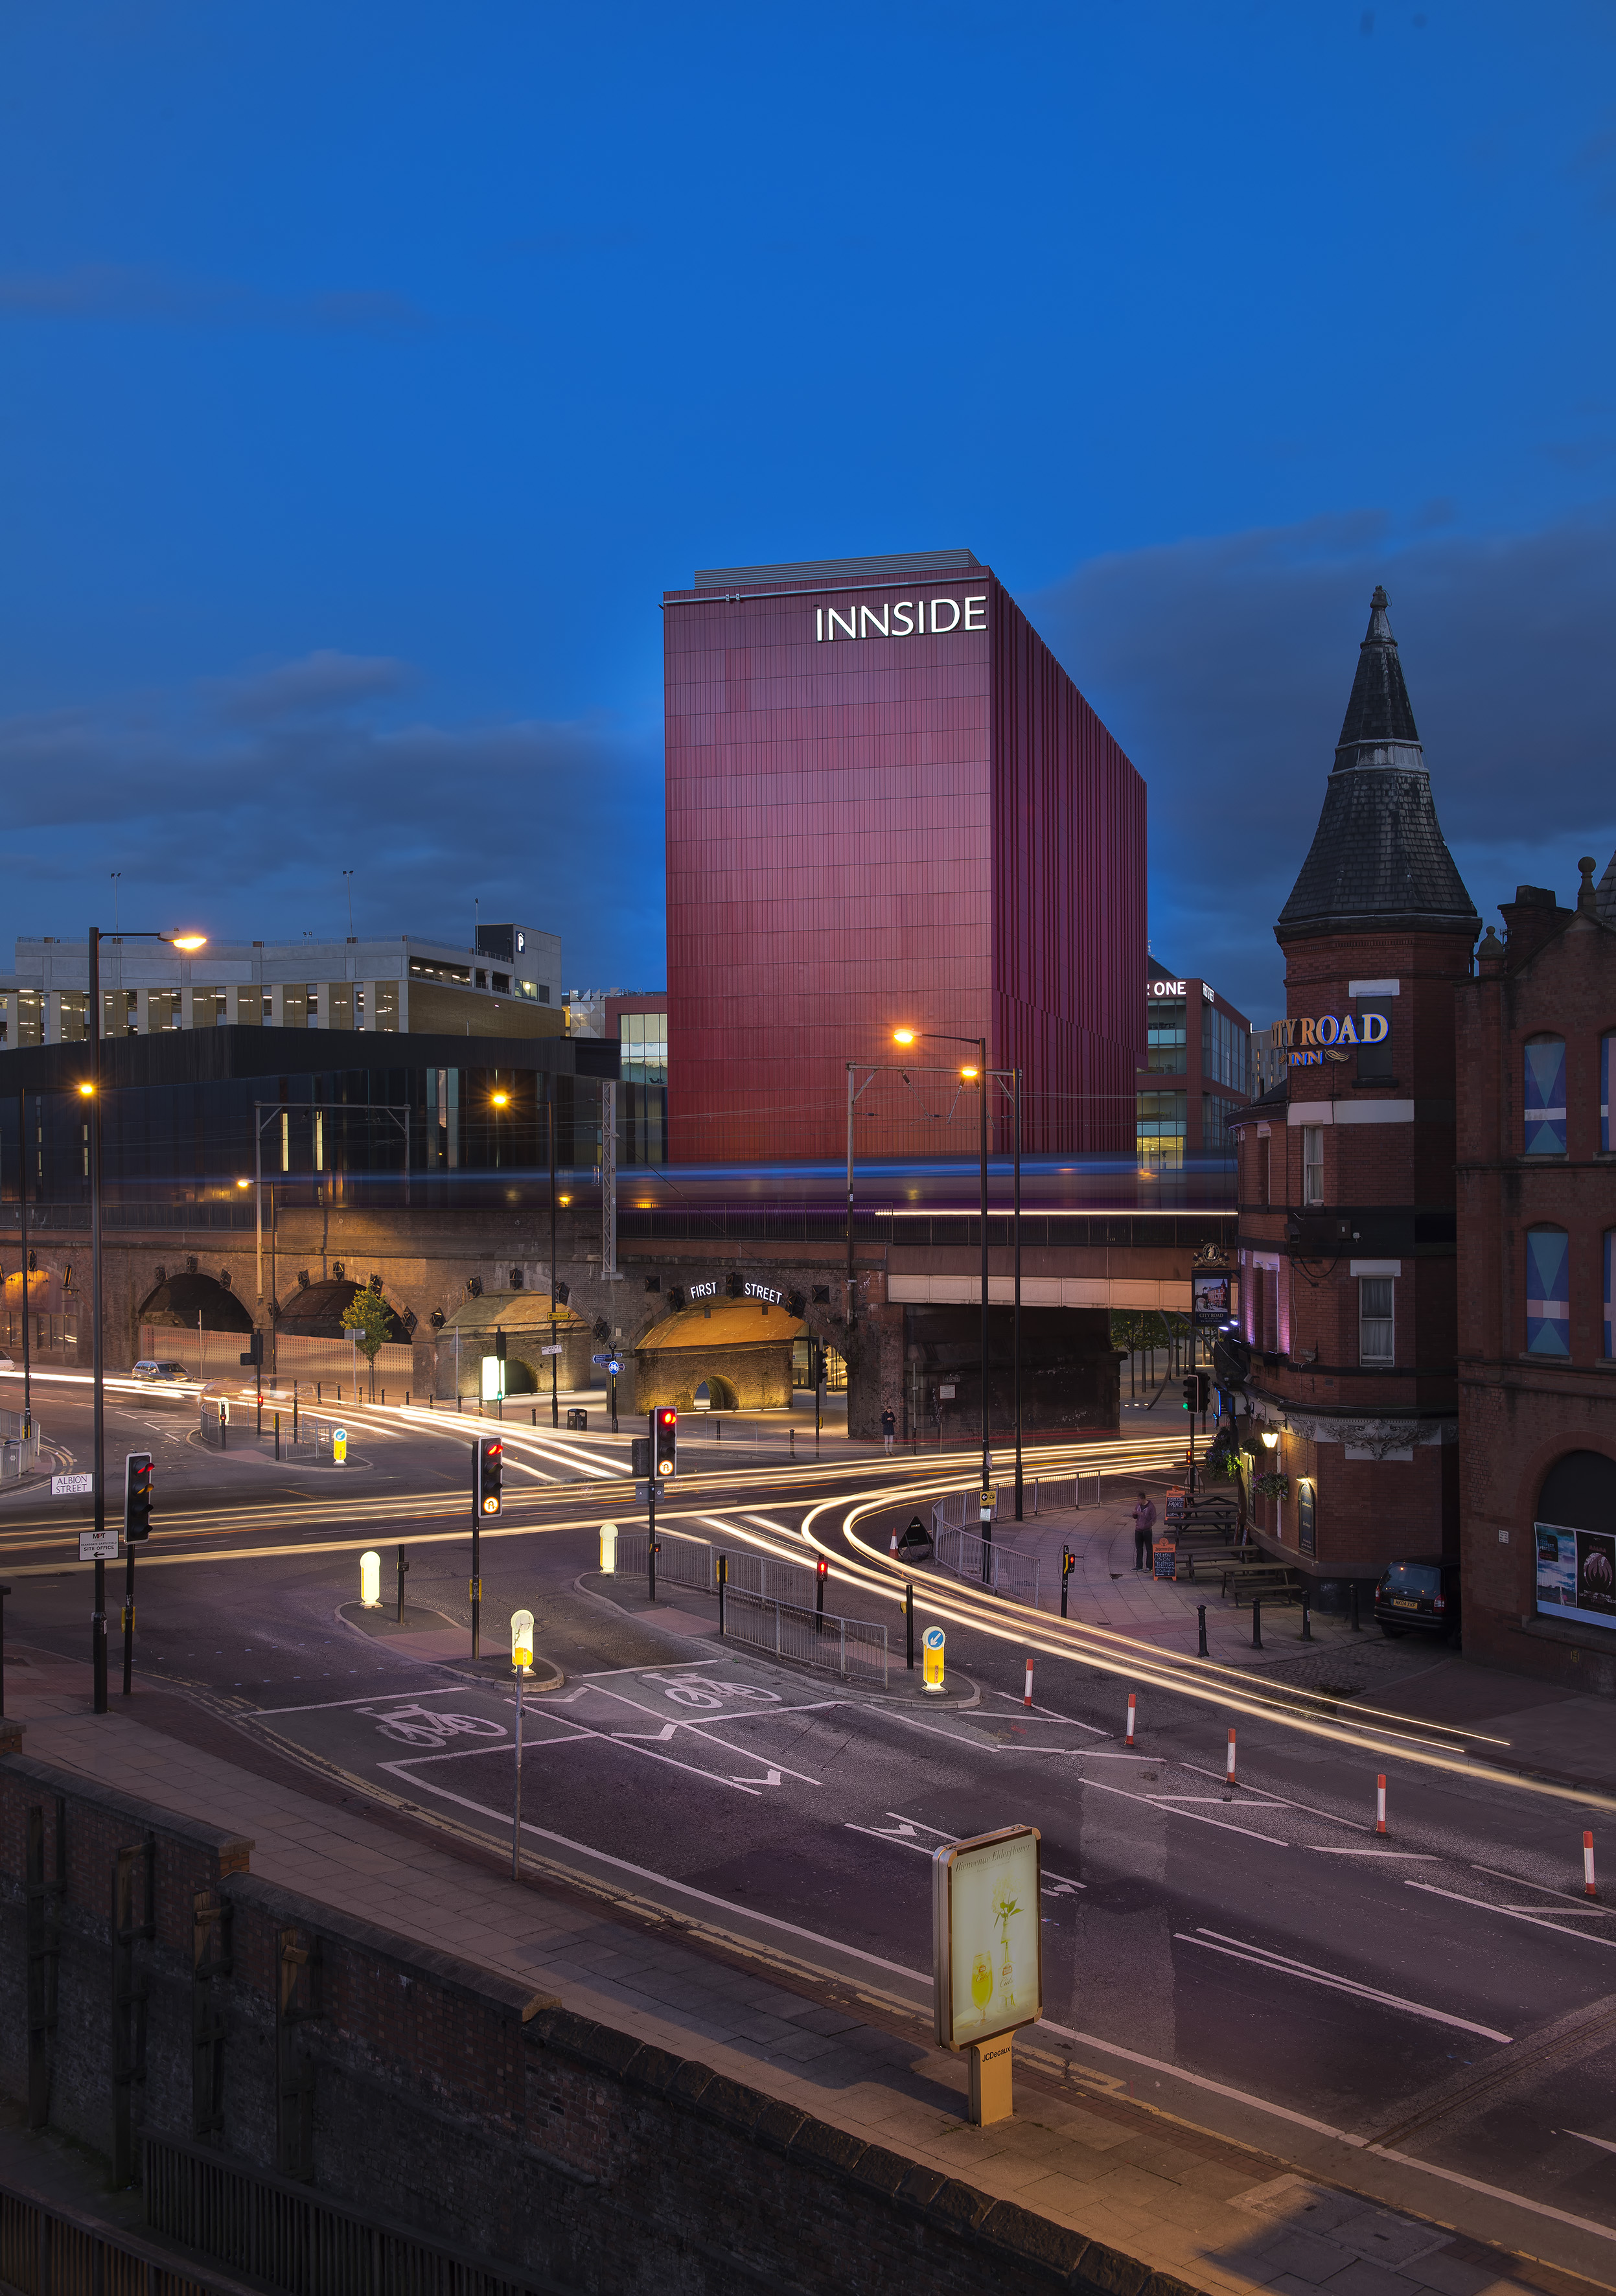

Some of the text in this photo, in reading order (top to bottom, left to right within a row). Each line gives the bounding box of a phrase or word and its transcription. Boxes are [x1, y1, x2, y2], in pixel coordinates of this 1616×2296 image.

[816, 596, 987, 642] INNSIDE
[1153, 981, 1186, 996] ONE
[1300, 1014, 1389, 1045] ROAD
[1287, 1050, 1323, 1067] INN
[690, 1282, 783, 1304] FIRST STREET
[56, 1484, 87, 1494] STREET
[57, 1476, 87, 1485] ALBION
[956, 1857, 991, 1872] Bienvenue
[991, 1844, 1031, 1861] Elderflower
[982, 2046, 1011, 2062] JCDecaux
